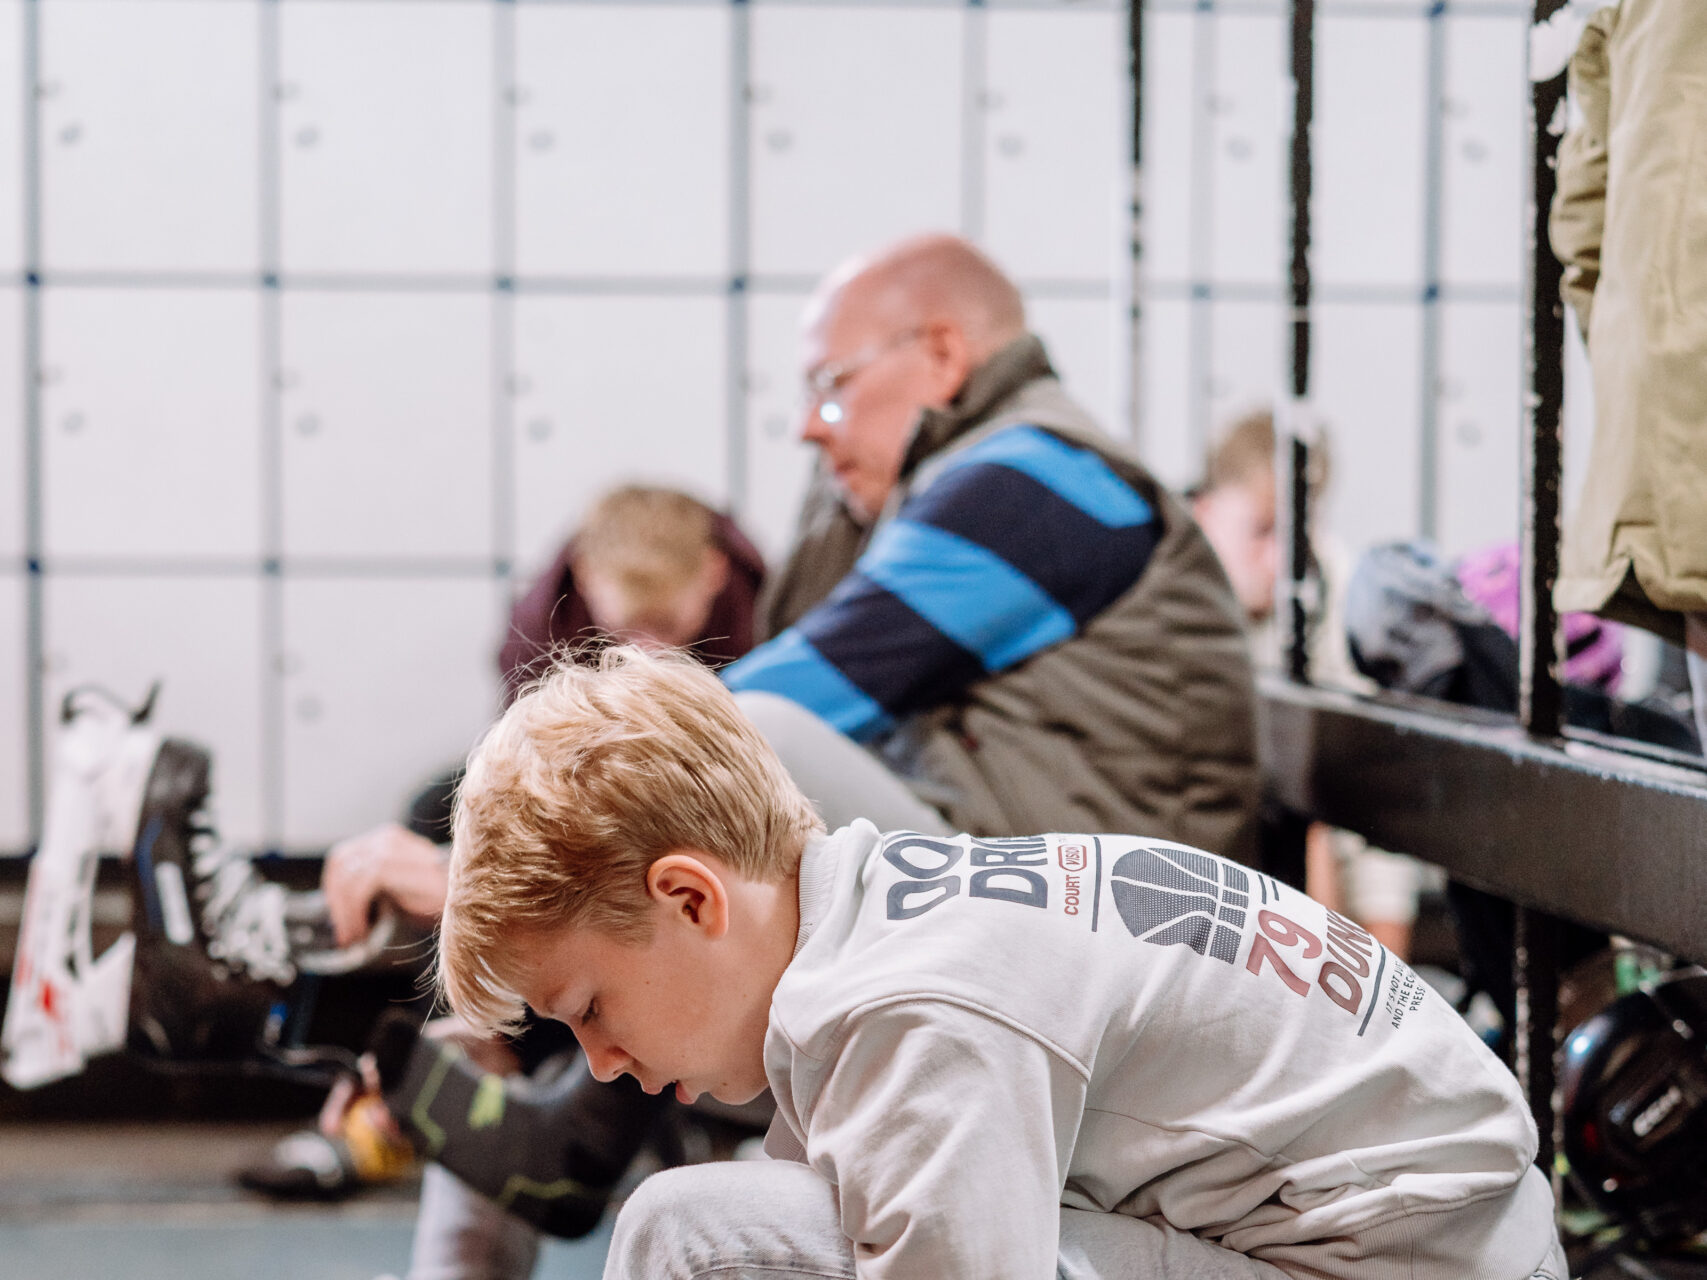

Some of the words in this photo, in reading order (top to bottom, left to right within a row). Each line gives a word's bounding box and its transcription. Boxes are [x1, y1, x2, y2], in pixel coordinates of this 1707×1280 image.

[883, 832, 963, 920] DO
[1064, 874, 1081, 916] COURT
[1246, 909, 1322, 997] 79
[1390, 975, 1401, 996] NOT
[1397, 989, 1410, 1008] THE
[1391, 1008, 1404, 1029] AND
